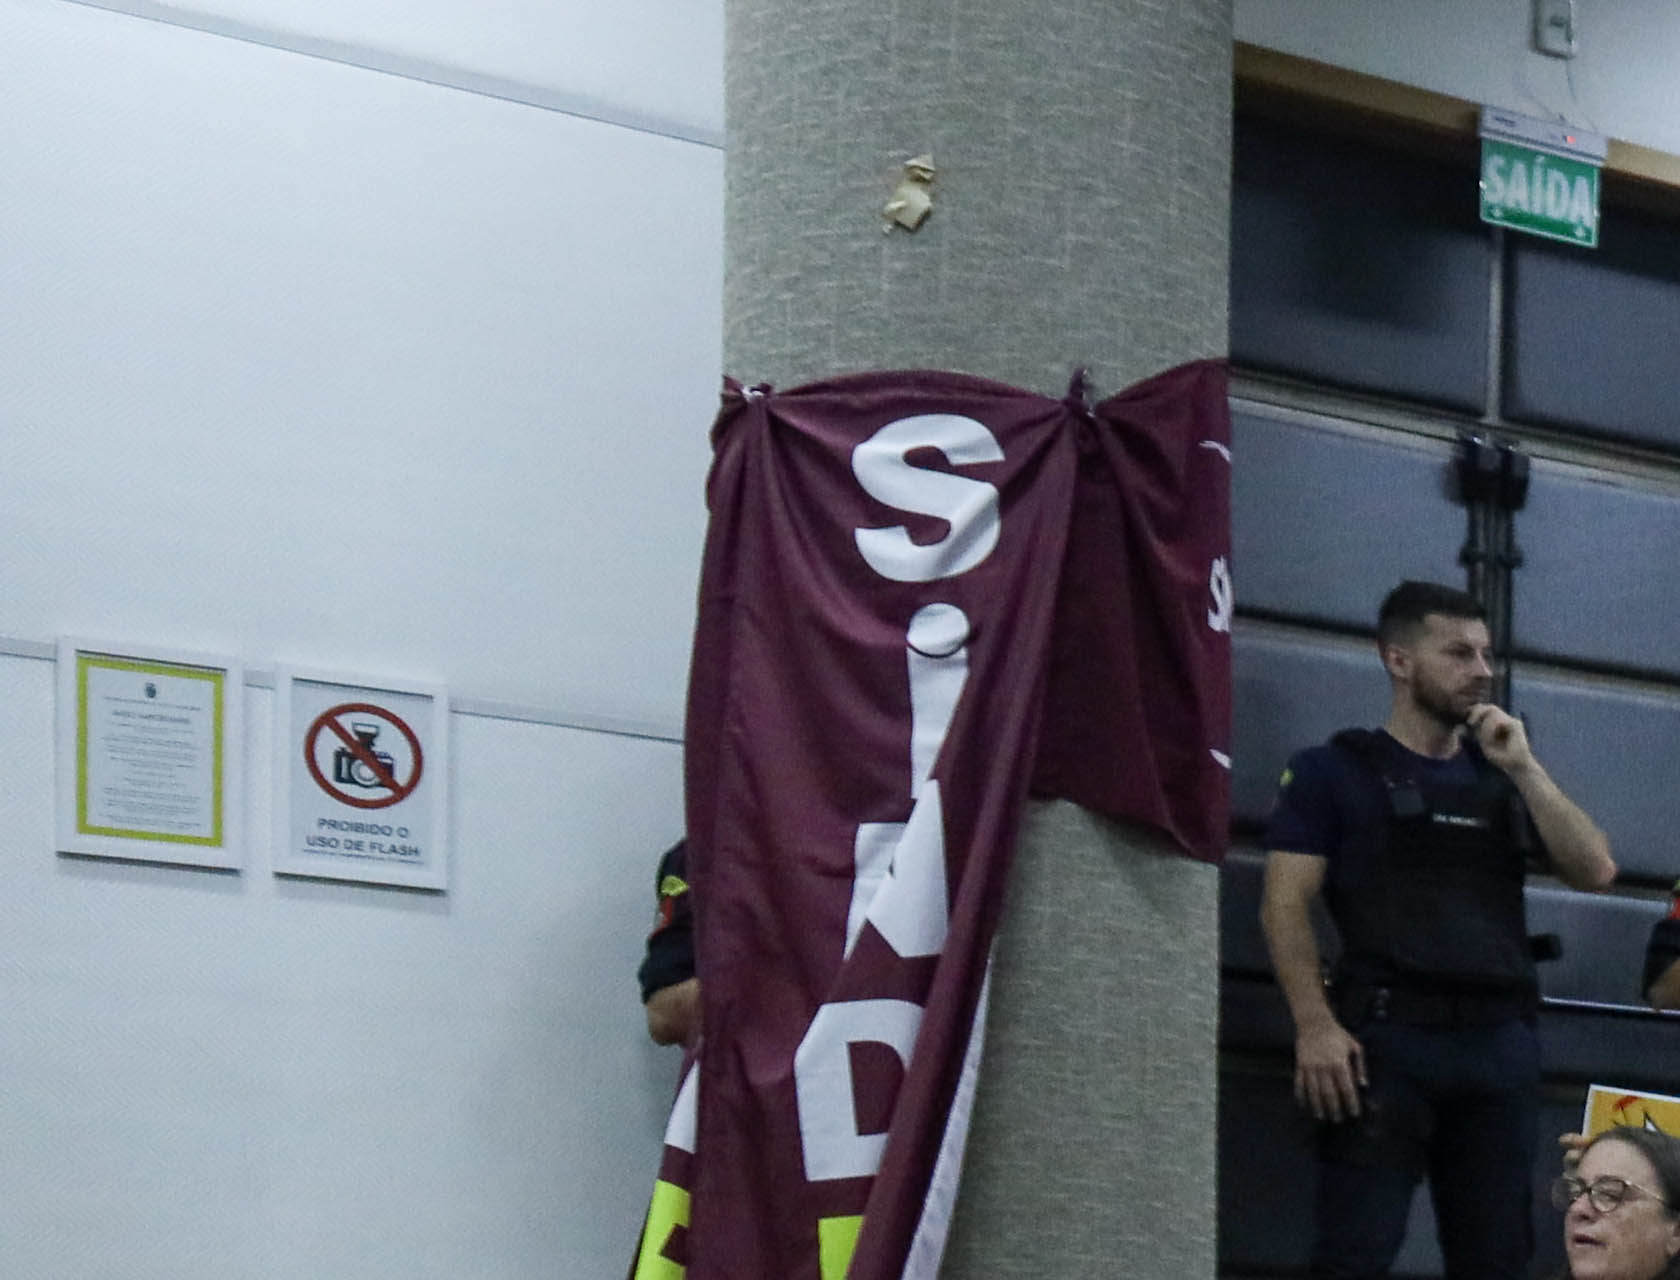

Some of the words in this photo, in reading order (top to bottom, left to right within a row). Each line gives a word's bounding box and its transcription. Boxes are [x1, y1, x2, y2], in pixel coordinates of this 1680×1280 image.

[1485, 154, 1593, 229] SAÍDA
[318, 818, 391, 838] PROIBIDO
[396, 827, 409, 838] O
[306, 835, 338, 849] USO
[343, 839, 363, 851] DE
[369, 841, 419, 857] FLASH
